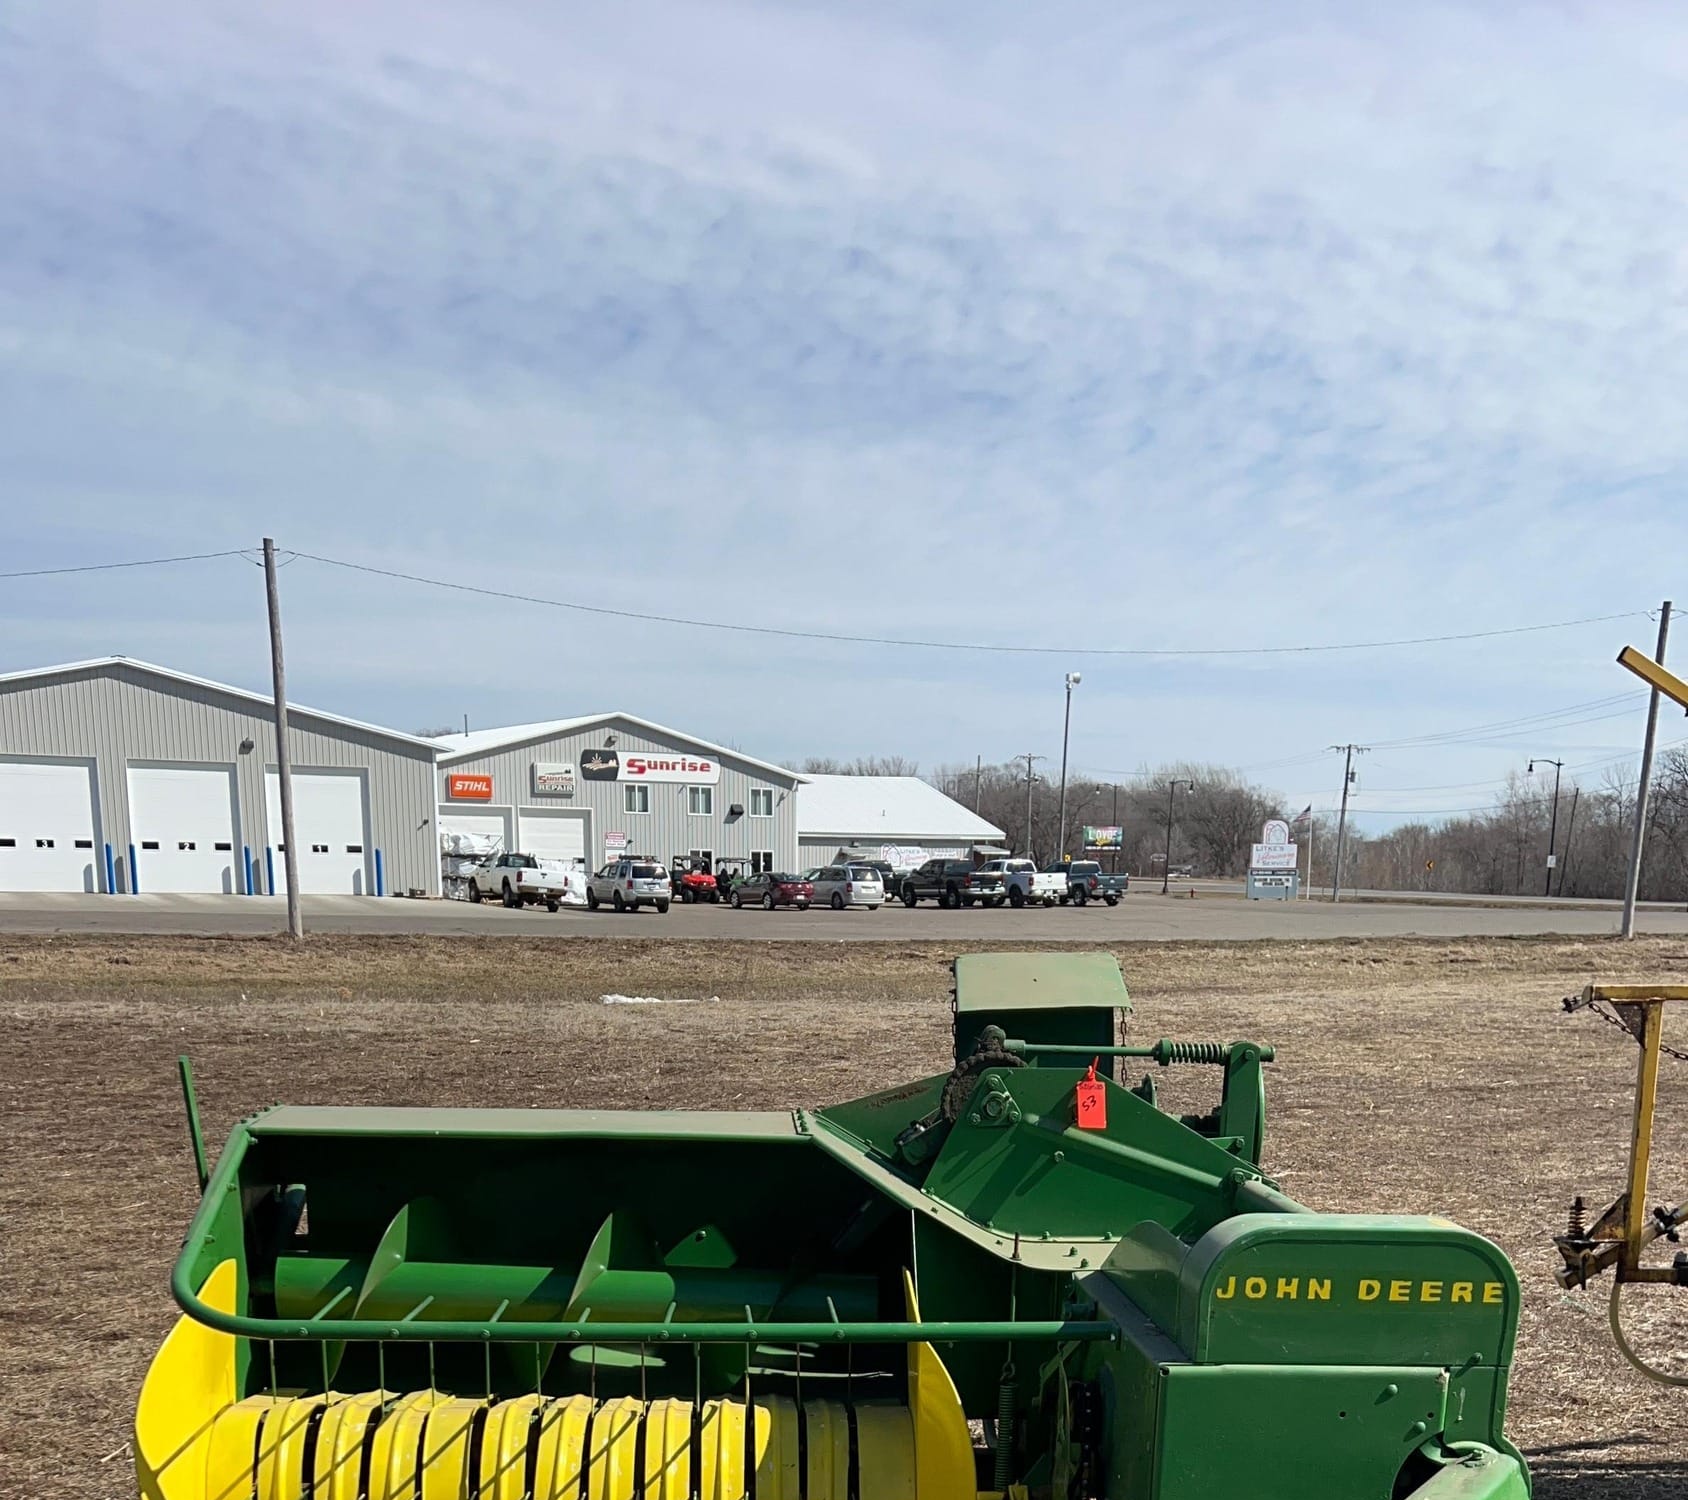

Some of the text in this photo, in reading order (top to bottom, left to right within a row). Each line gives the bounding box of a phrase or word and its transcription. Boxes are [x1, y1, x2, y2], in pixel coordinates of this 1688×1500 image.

[626, 758, 711, 775] Sunrise
[538, 775, 574, 783] Sunrise
[454, 780, 490, 791] STIHL
[538, 784, 574, 792] REPAIR
[41, 840, 48, 848] 3
[183, 842, 191, 851] 2
[1216, 1276, 1505, 1303] JOHN DEERE
